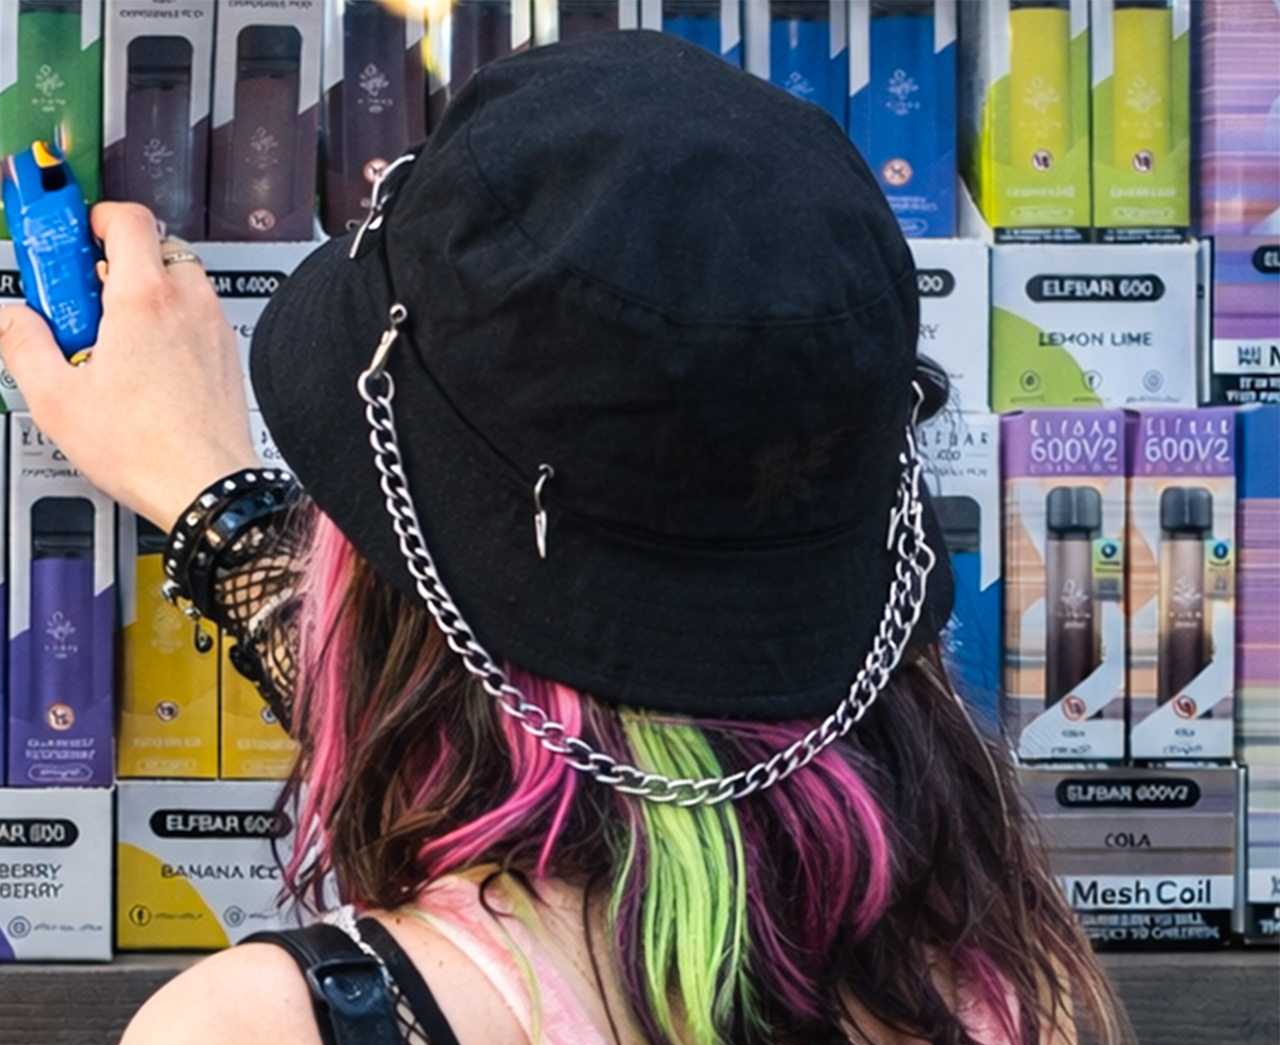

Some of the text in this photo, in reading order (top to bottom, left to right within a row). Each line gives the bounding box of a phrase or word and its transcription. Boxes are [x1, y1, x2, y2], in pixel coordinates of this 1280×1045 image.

[1042, 279, 1153, 296] ELFBAR 600
[1039, 331, 1153, 347] LEMON LIME
[1030, 439, 1118, 463] 600V2
[1145, 439, 1231, 463] 600V2
[166, 816, 238, 832] ELFBAR
[1104, 832, 1151, 847] COLA
[161, 864, 244, 879] BANANA
[1072, 880, 1211, 905] Mesh Coil
